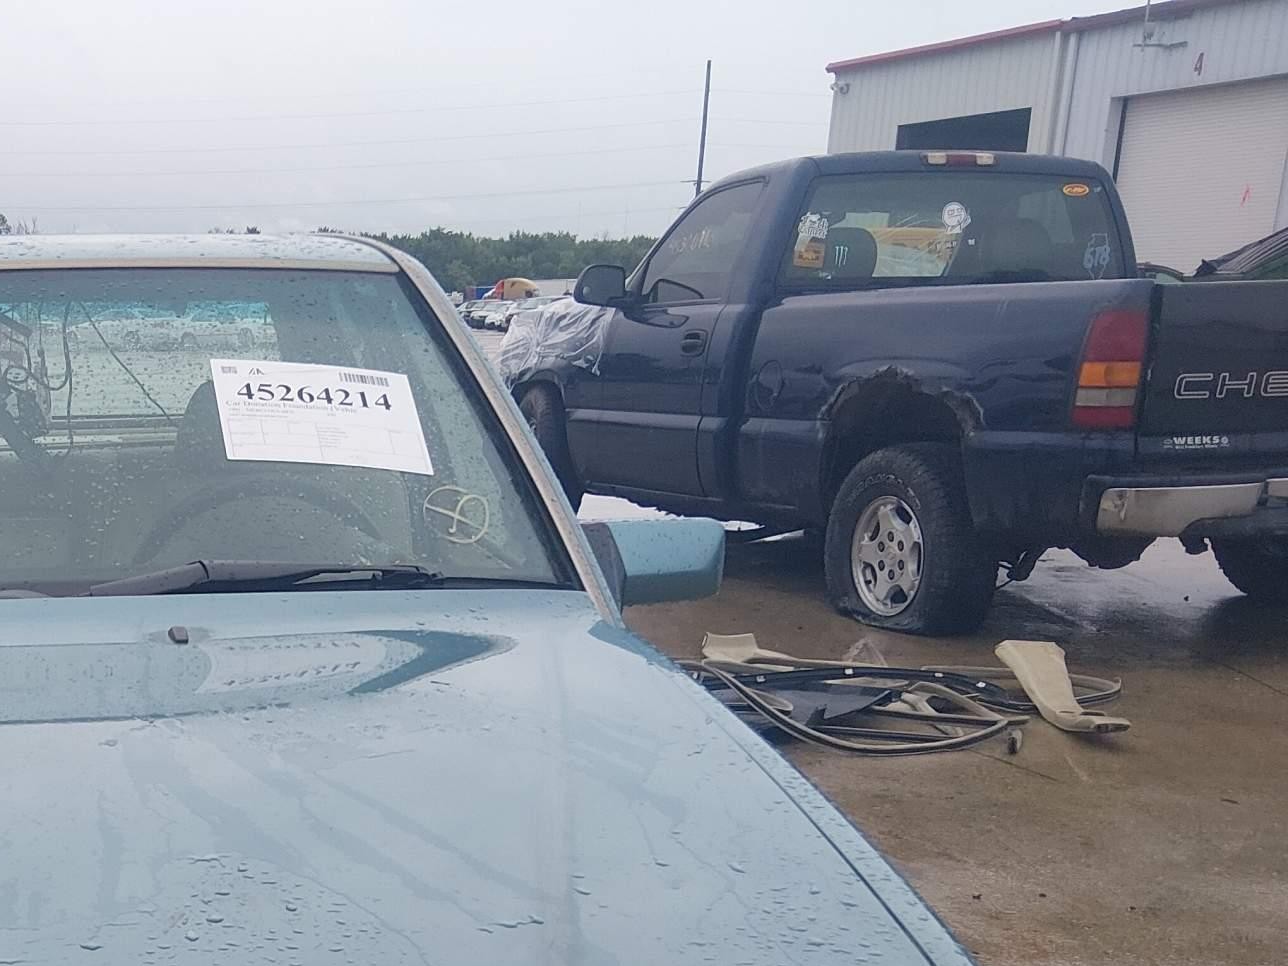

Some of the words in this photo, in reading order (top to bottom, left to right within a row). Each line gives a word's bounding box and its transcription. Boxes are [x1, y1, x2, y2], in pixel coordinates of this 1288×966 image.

[1194, 52, 1204, 76] 4
[237, 383, 392, 411] 45264214
[1173, 435, 1220, 445] WEEKS
